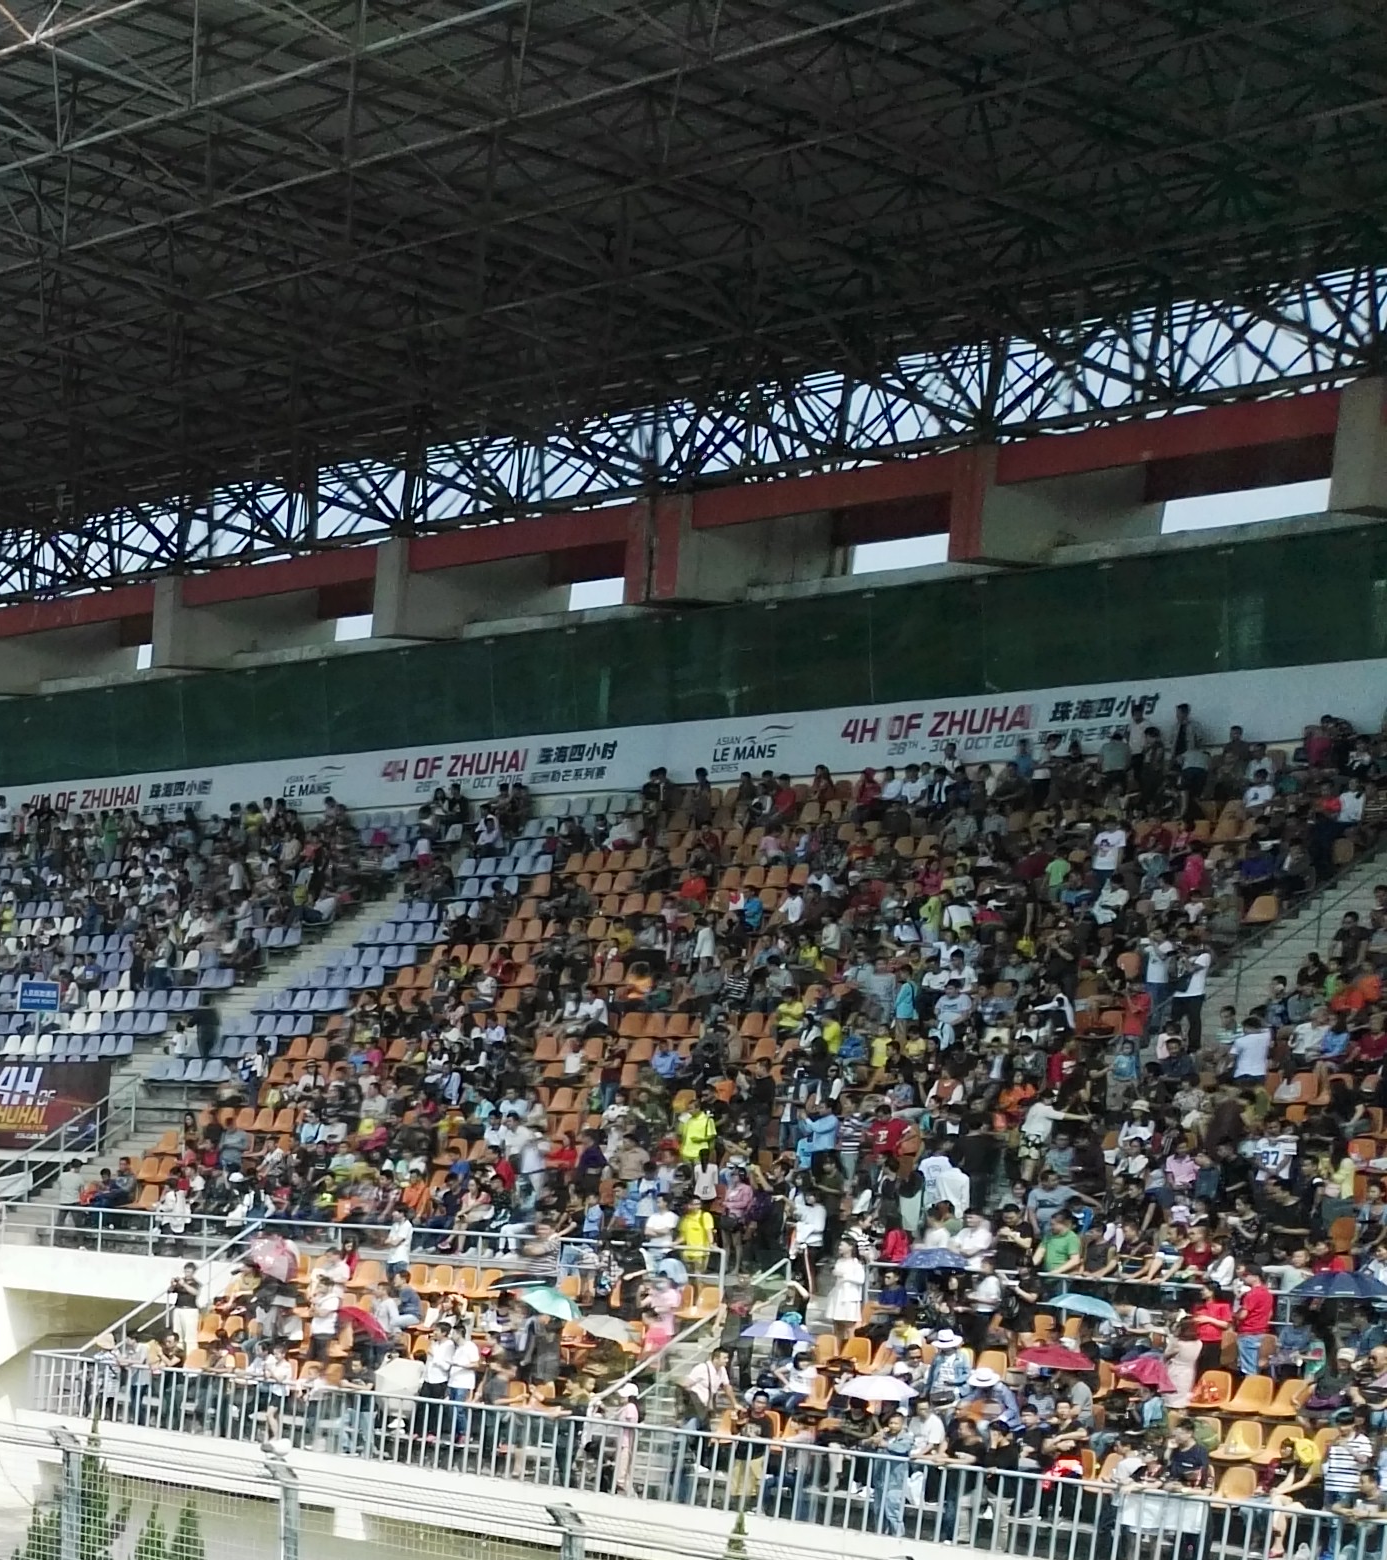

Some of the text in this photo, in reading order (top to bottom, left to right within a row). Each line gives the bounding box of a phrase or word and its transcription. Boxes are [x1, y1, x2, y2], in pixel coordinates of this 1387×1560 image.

[841, 717, 880, 744] 4H
[888, 712, 924, 740] OF
[716, 736, 741, 746] ASIAN
[964, 736, 992, 750] OCT
[537, 740, 617, 765] 珠海四小时
[712, 744, 777, 762] LE MANS
[382, 748, 529, 781] 4H OF ZHUHAI
[80, 784, 141, 809] ZHUHAI
[283, 785, 296, 797] LE
